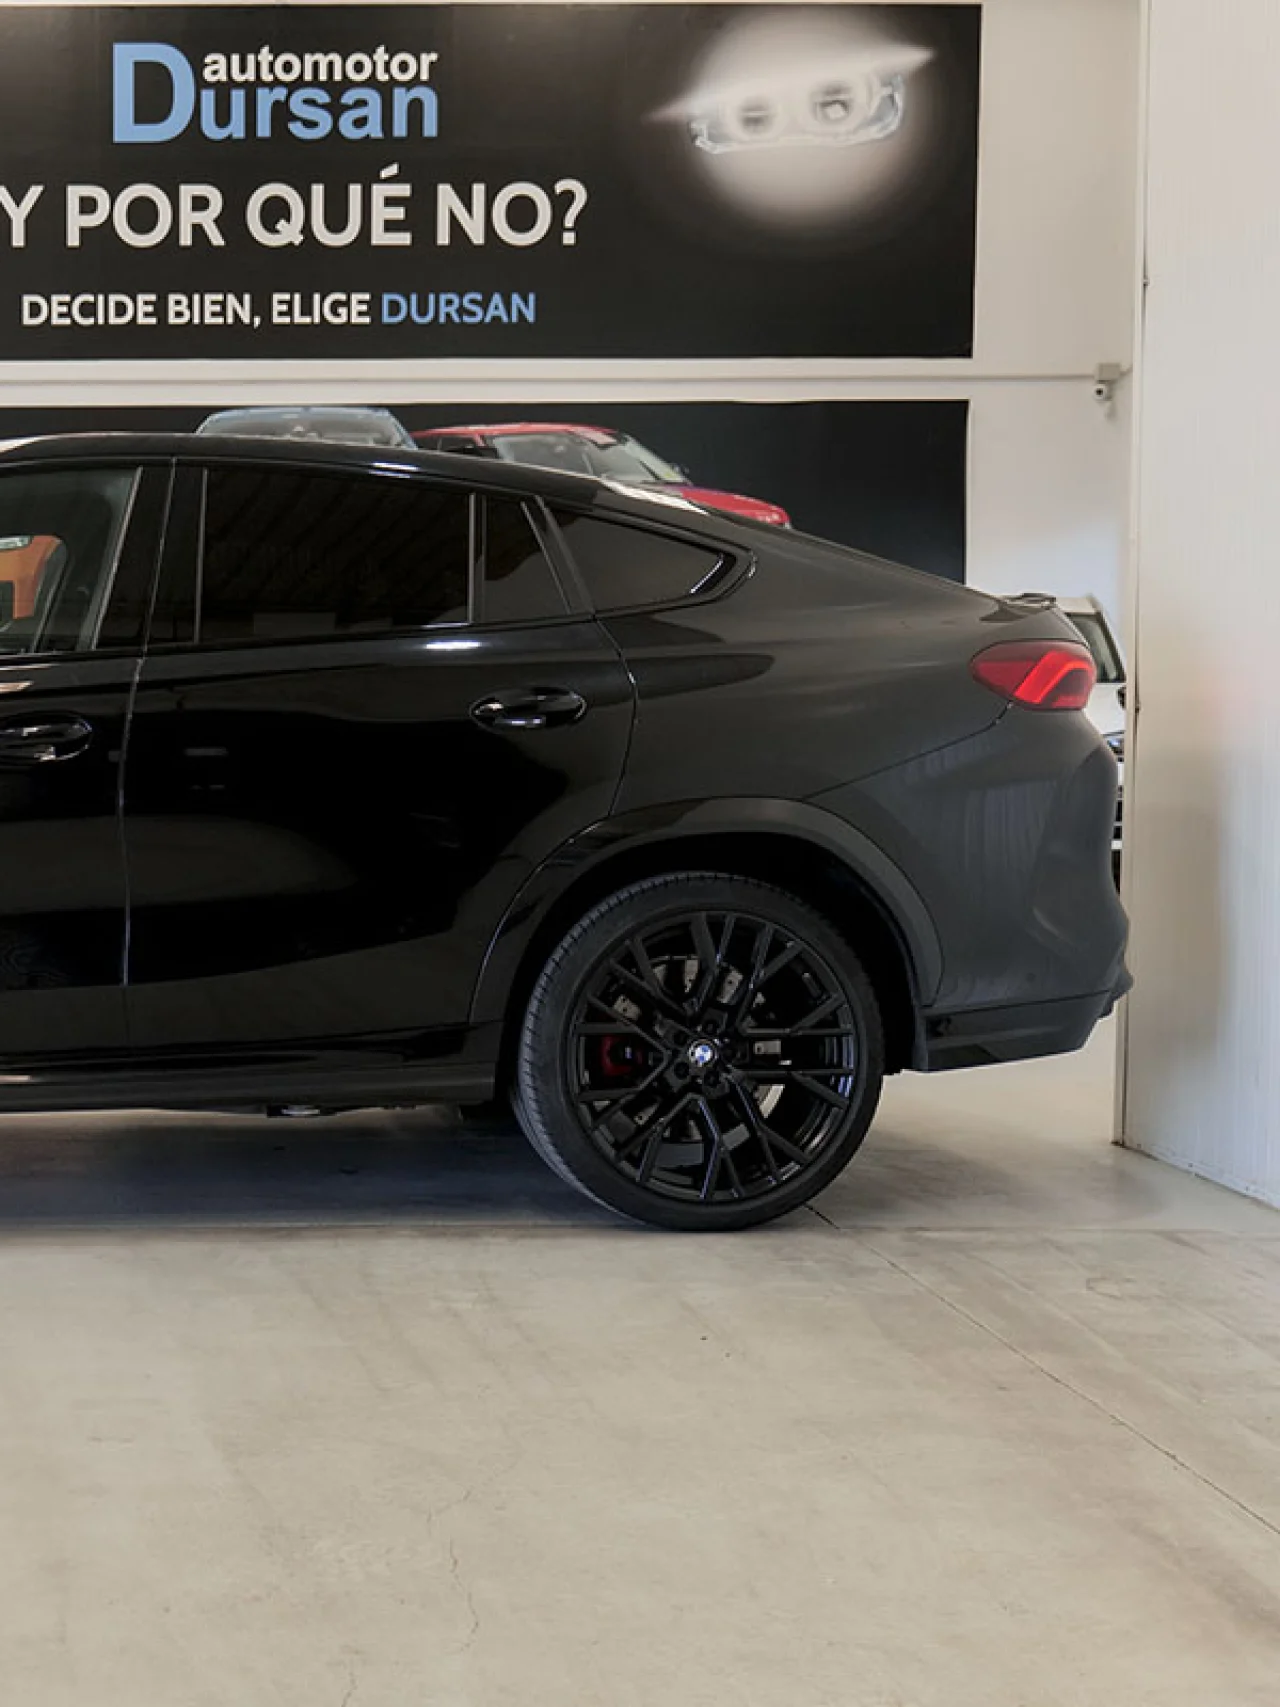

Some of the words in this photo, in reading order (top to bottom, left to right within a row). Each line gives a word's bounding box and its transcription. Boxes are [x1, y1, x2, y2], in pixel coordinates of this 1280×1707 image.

[113, 42, 438, 143] Dursan
[203, 44, 438, 82] automotor
[66, 183, 225, 248] POR
[246, 163, 413, 247] QUÉ
[436, 178, 589, 247] NO?
[22, 293, 157, 326] DECIDE
[167, 293, 261, 329] BIEN,
[272, 292, 372, 325] ELIGE
[381, 292, 536, 324] DURSAN
